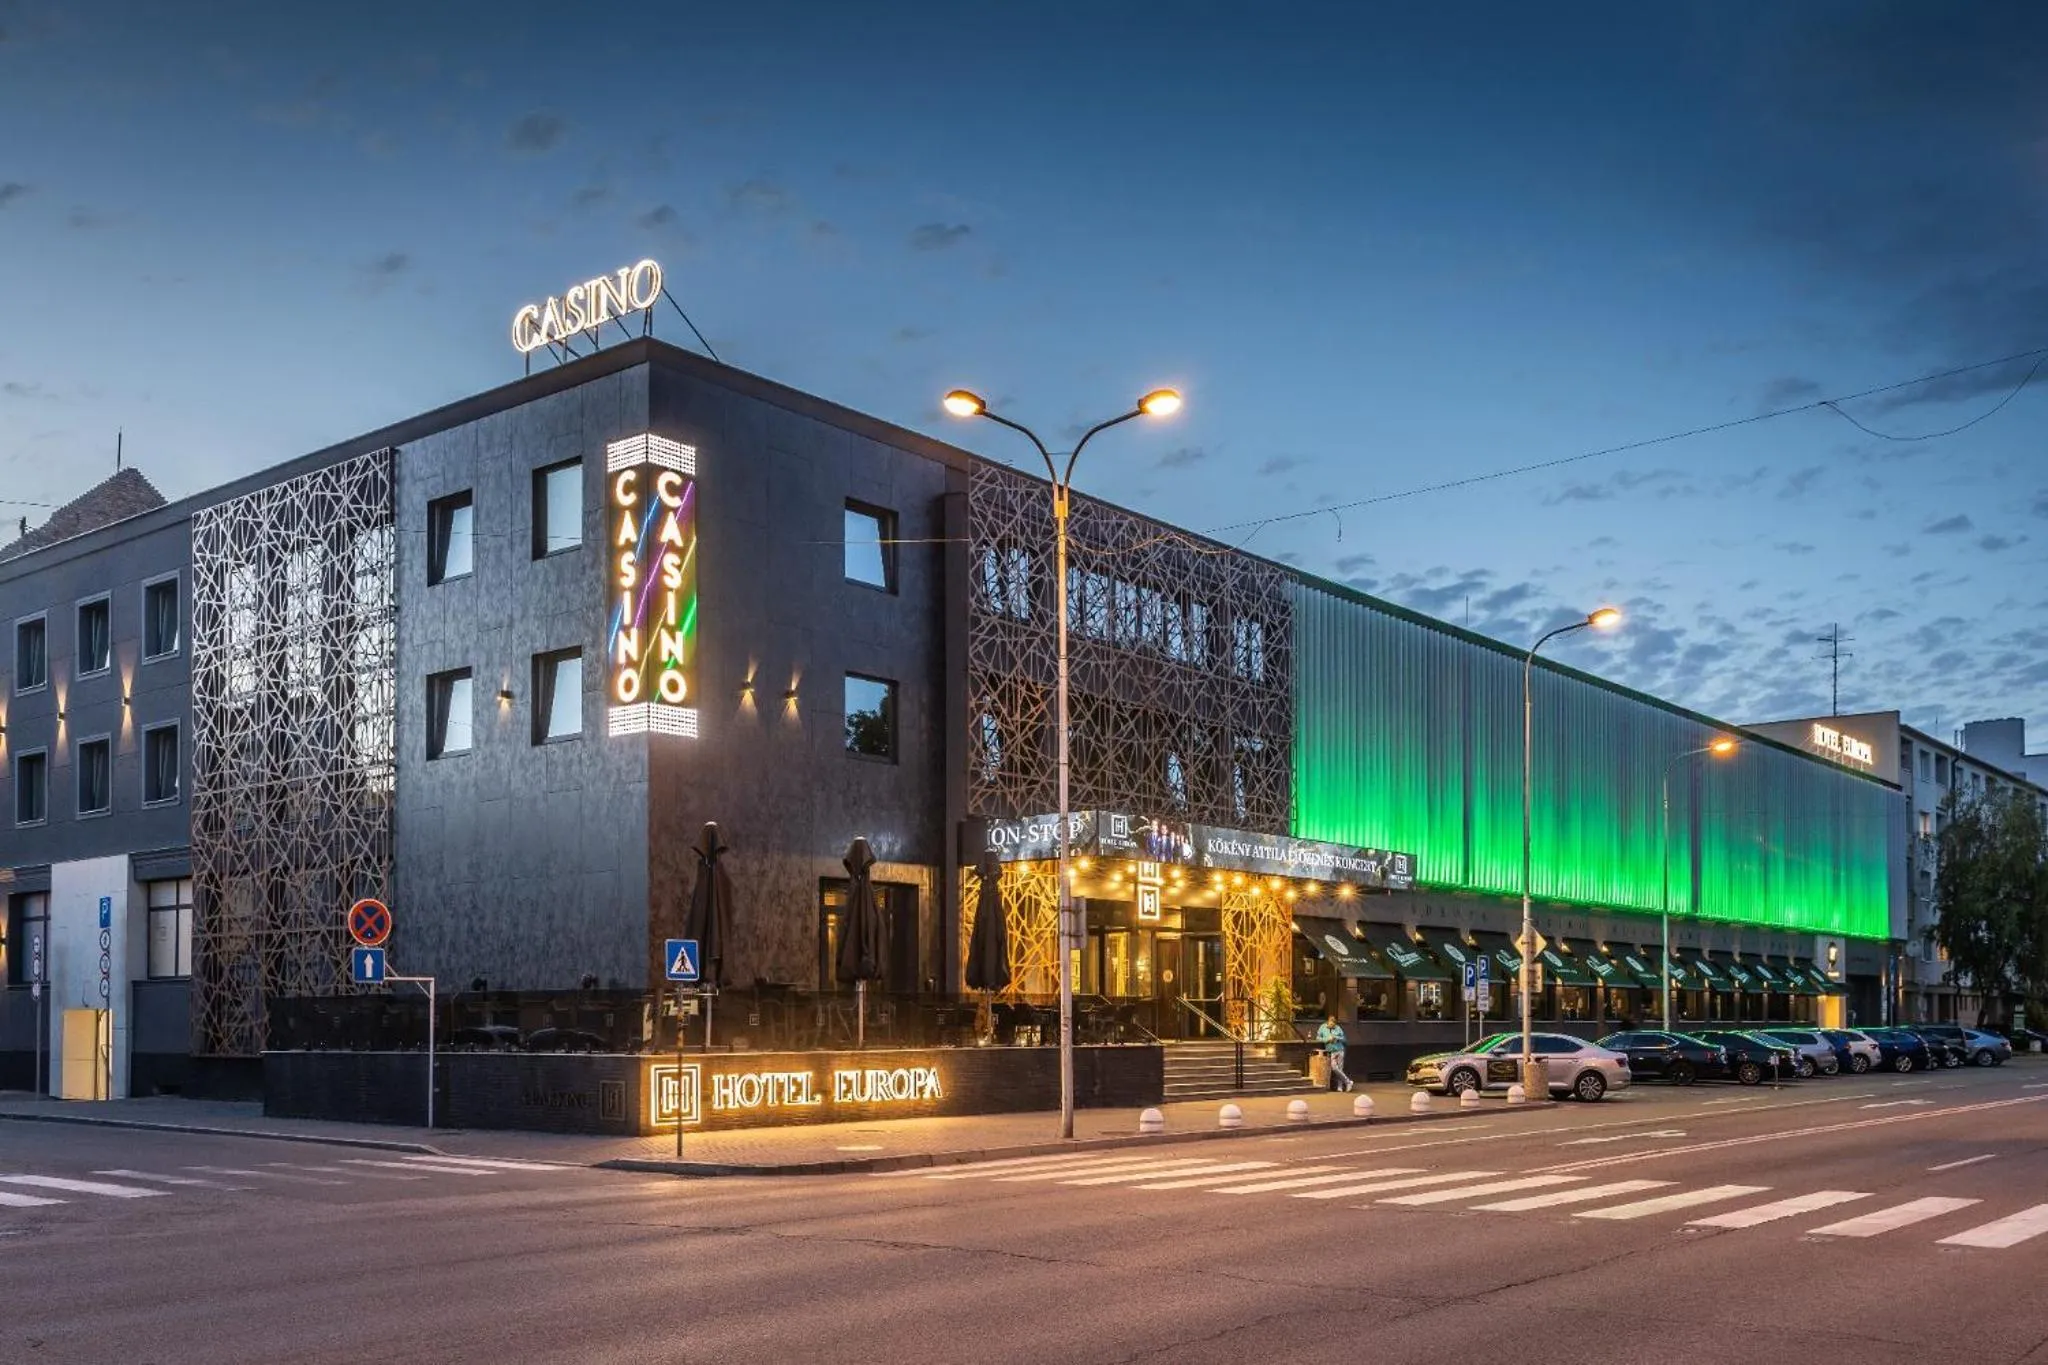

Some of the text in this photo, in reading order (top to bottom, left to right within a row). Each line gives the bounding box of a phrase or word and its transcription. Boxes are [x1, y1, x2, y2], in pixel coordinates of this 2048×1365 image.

[512, 259, 662, 352] CASINO
[615, 469, 640, 702] CASINO
[657, 471, 688, 703] CASINO
[1251, 844, 1287, 861] ATTILA
[1466, 965, 1474, 985] P
[712, 1067, 944, 1110] HOTEL EUROPA
